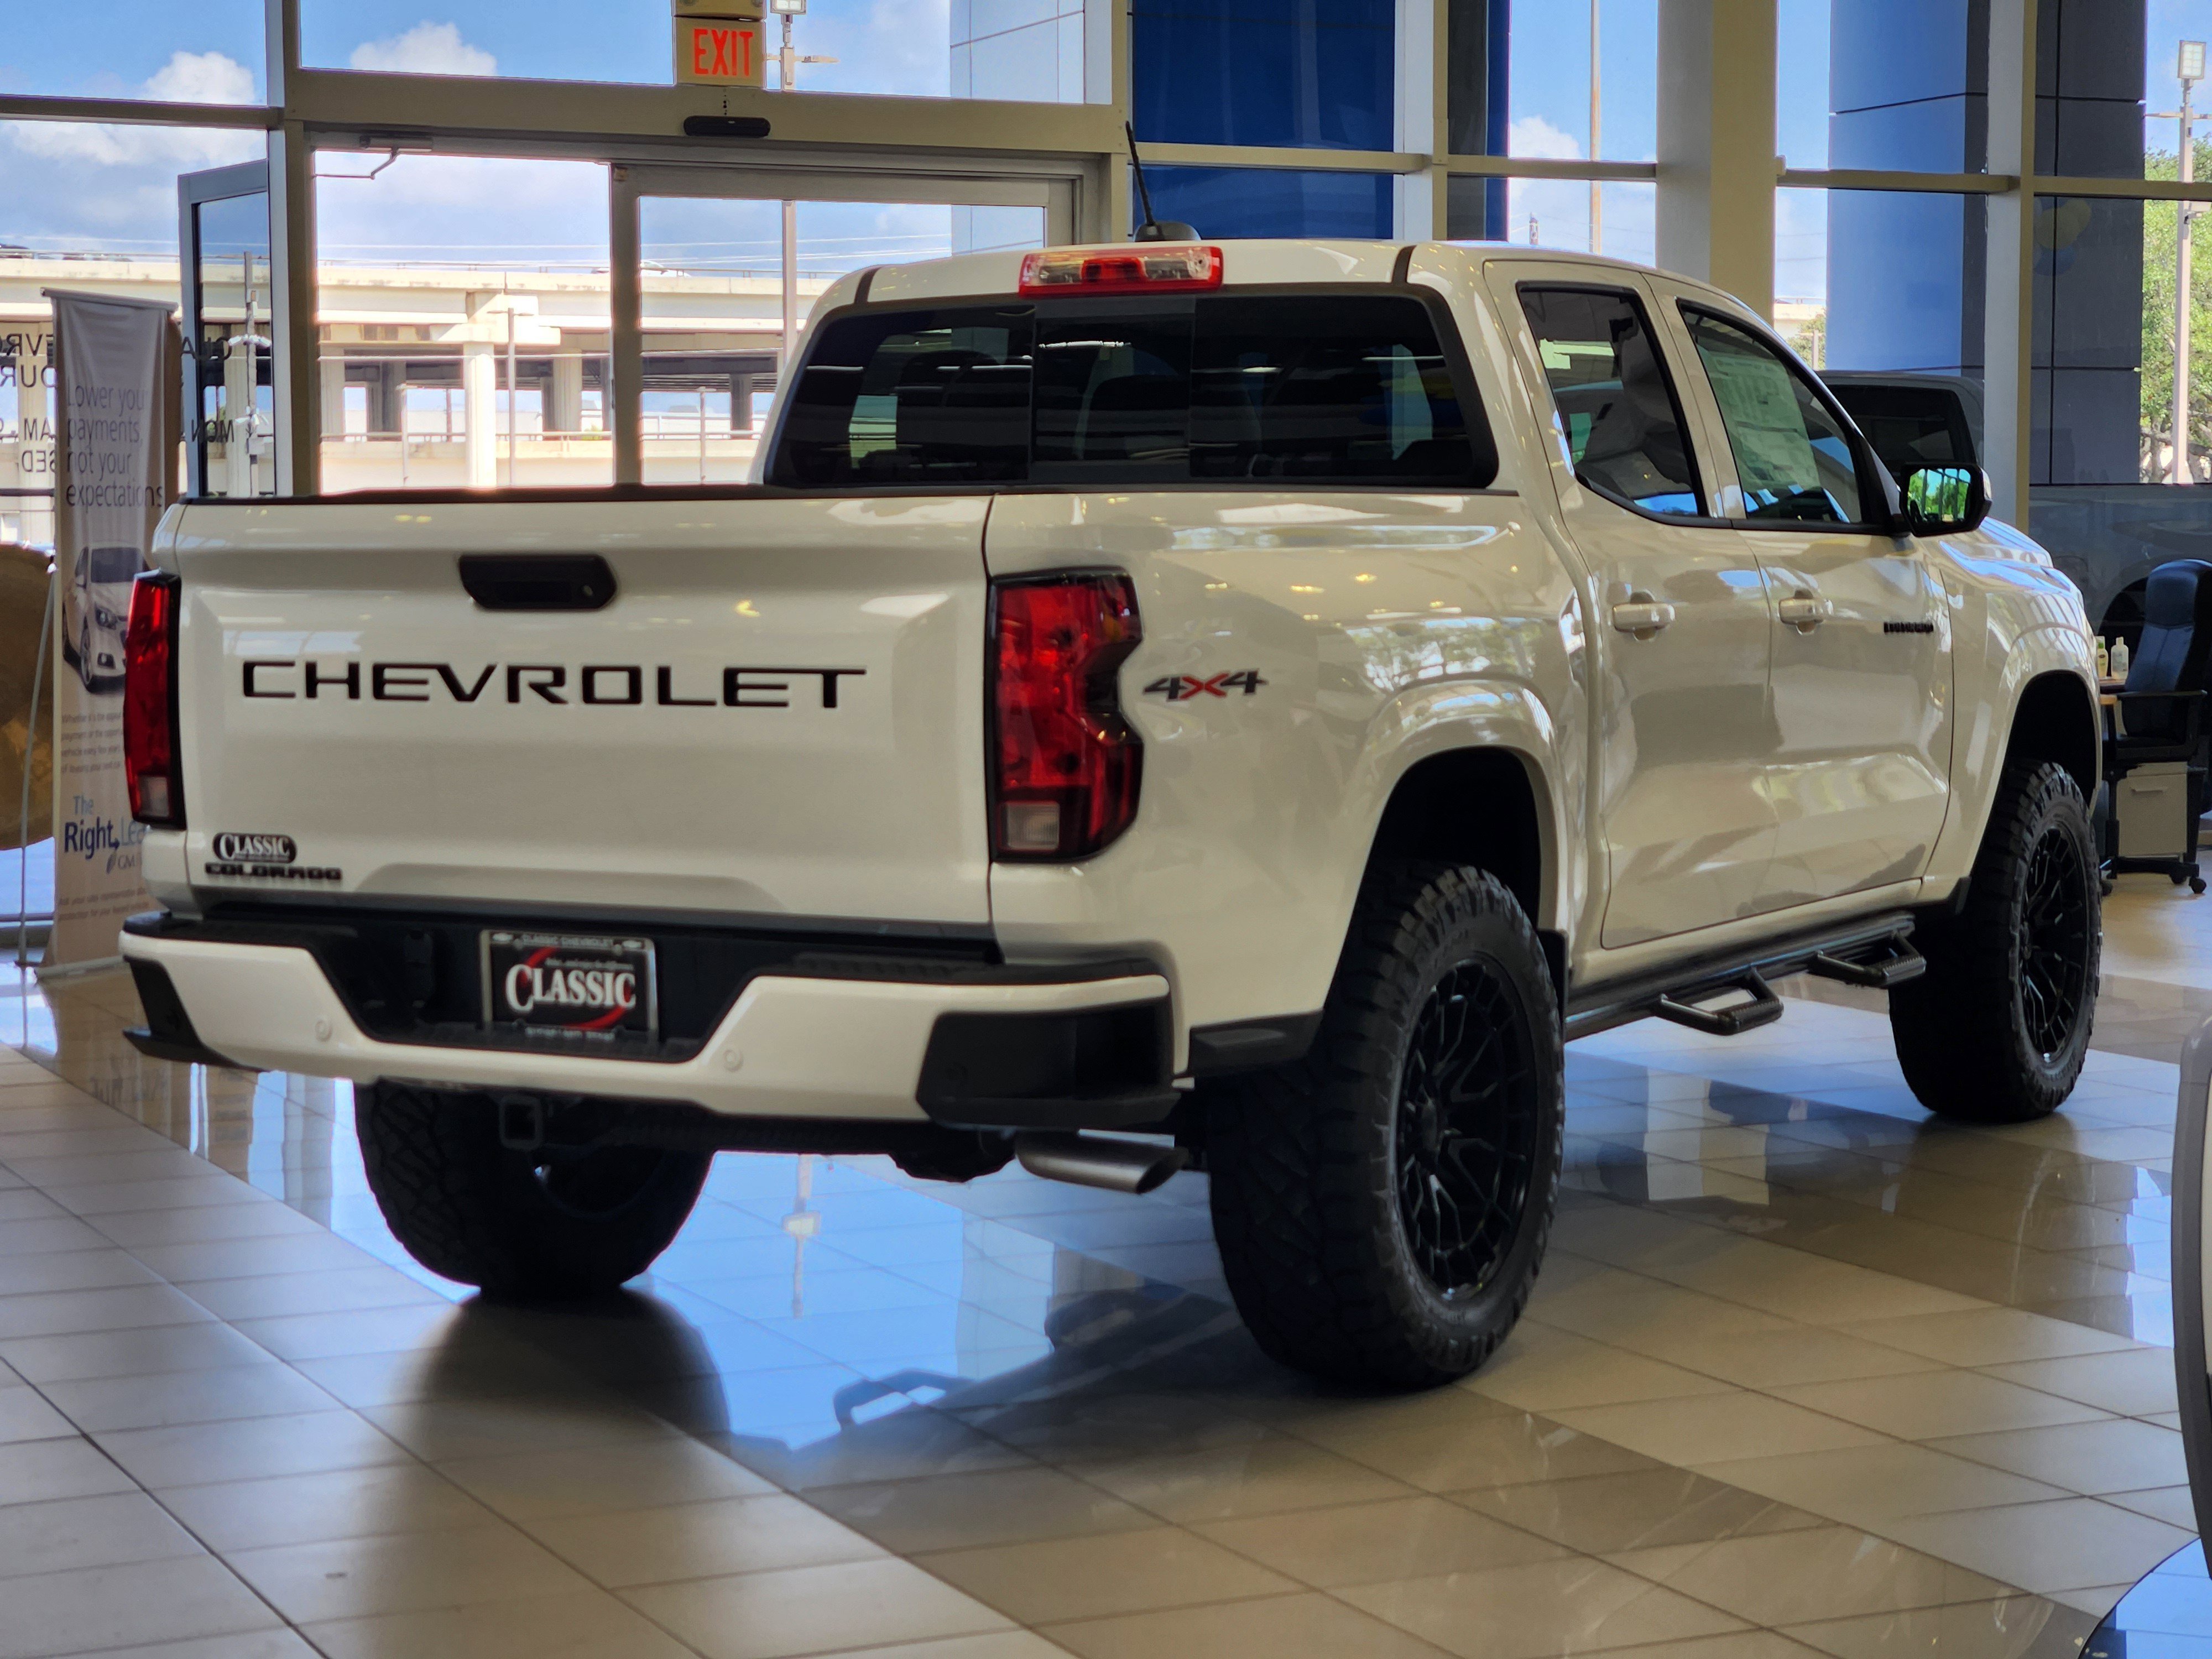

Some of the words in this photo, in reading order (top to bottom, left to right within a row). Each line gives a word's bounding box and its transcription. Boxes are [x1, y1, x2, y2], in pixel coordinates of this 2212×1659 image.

[693, 29, 754, 77] EXIT
[68, 379, 113, 408] Lower
[67, 447, 93, 474] not
[98, 452, 132, 481] your
[66, 479, 162, 513] expectations
[241, 661, 867, 709] CHEVROLET
[74, 795, 93, 815] The
[64, 816, 114, 859] Right
[220, 833, 290, 860] CLASSIC
[505, 964, 635, 1013] CLASSIC
